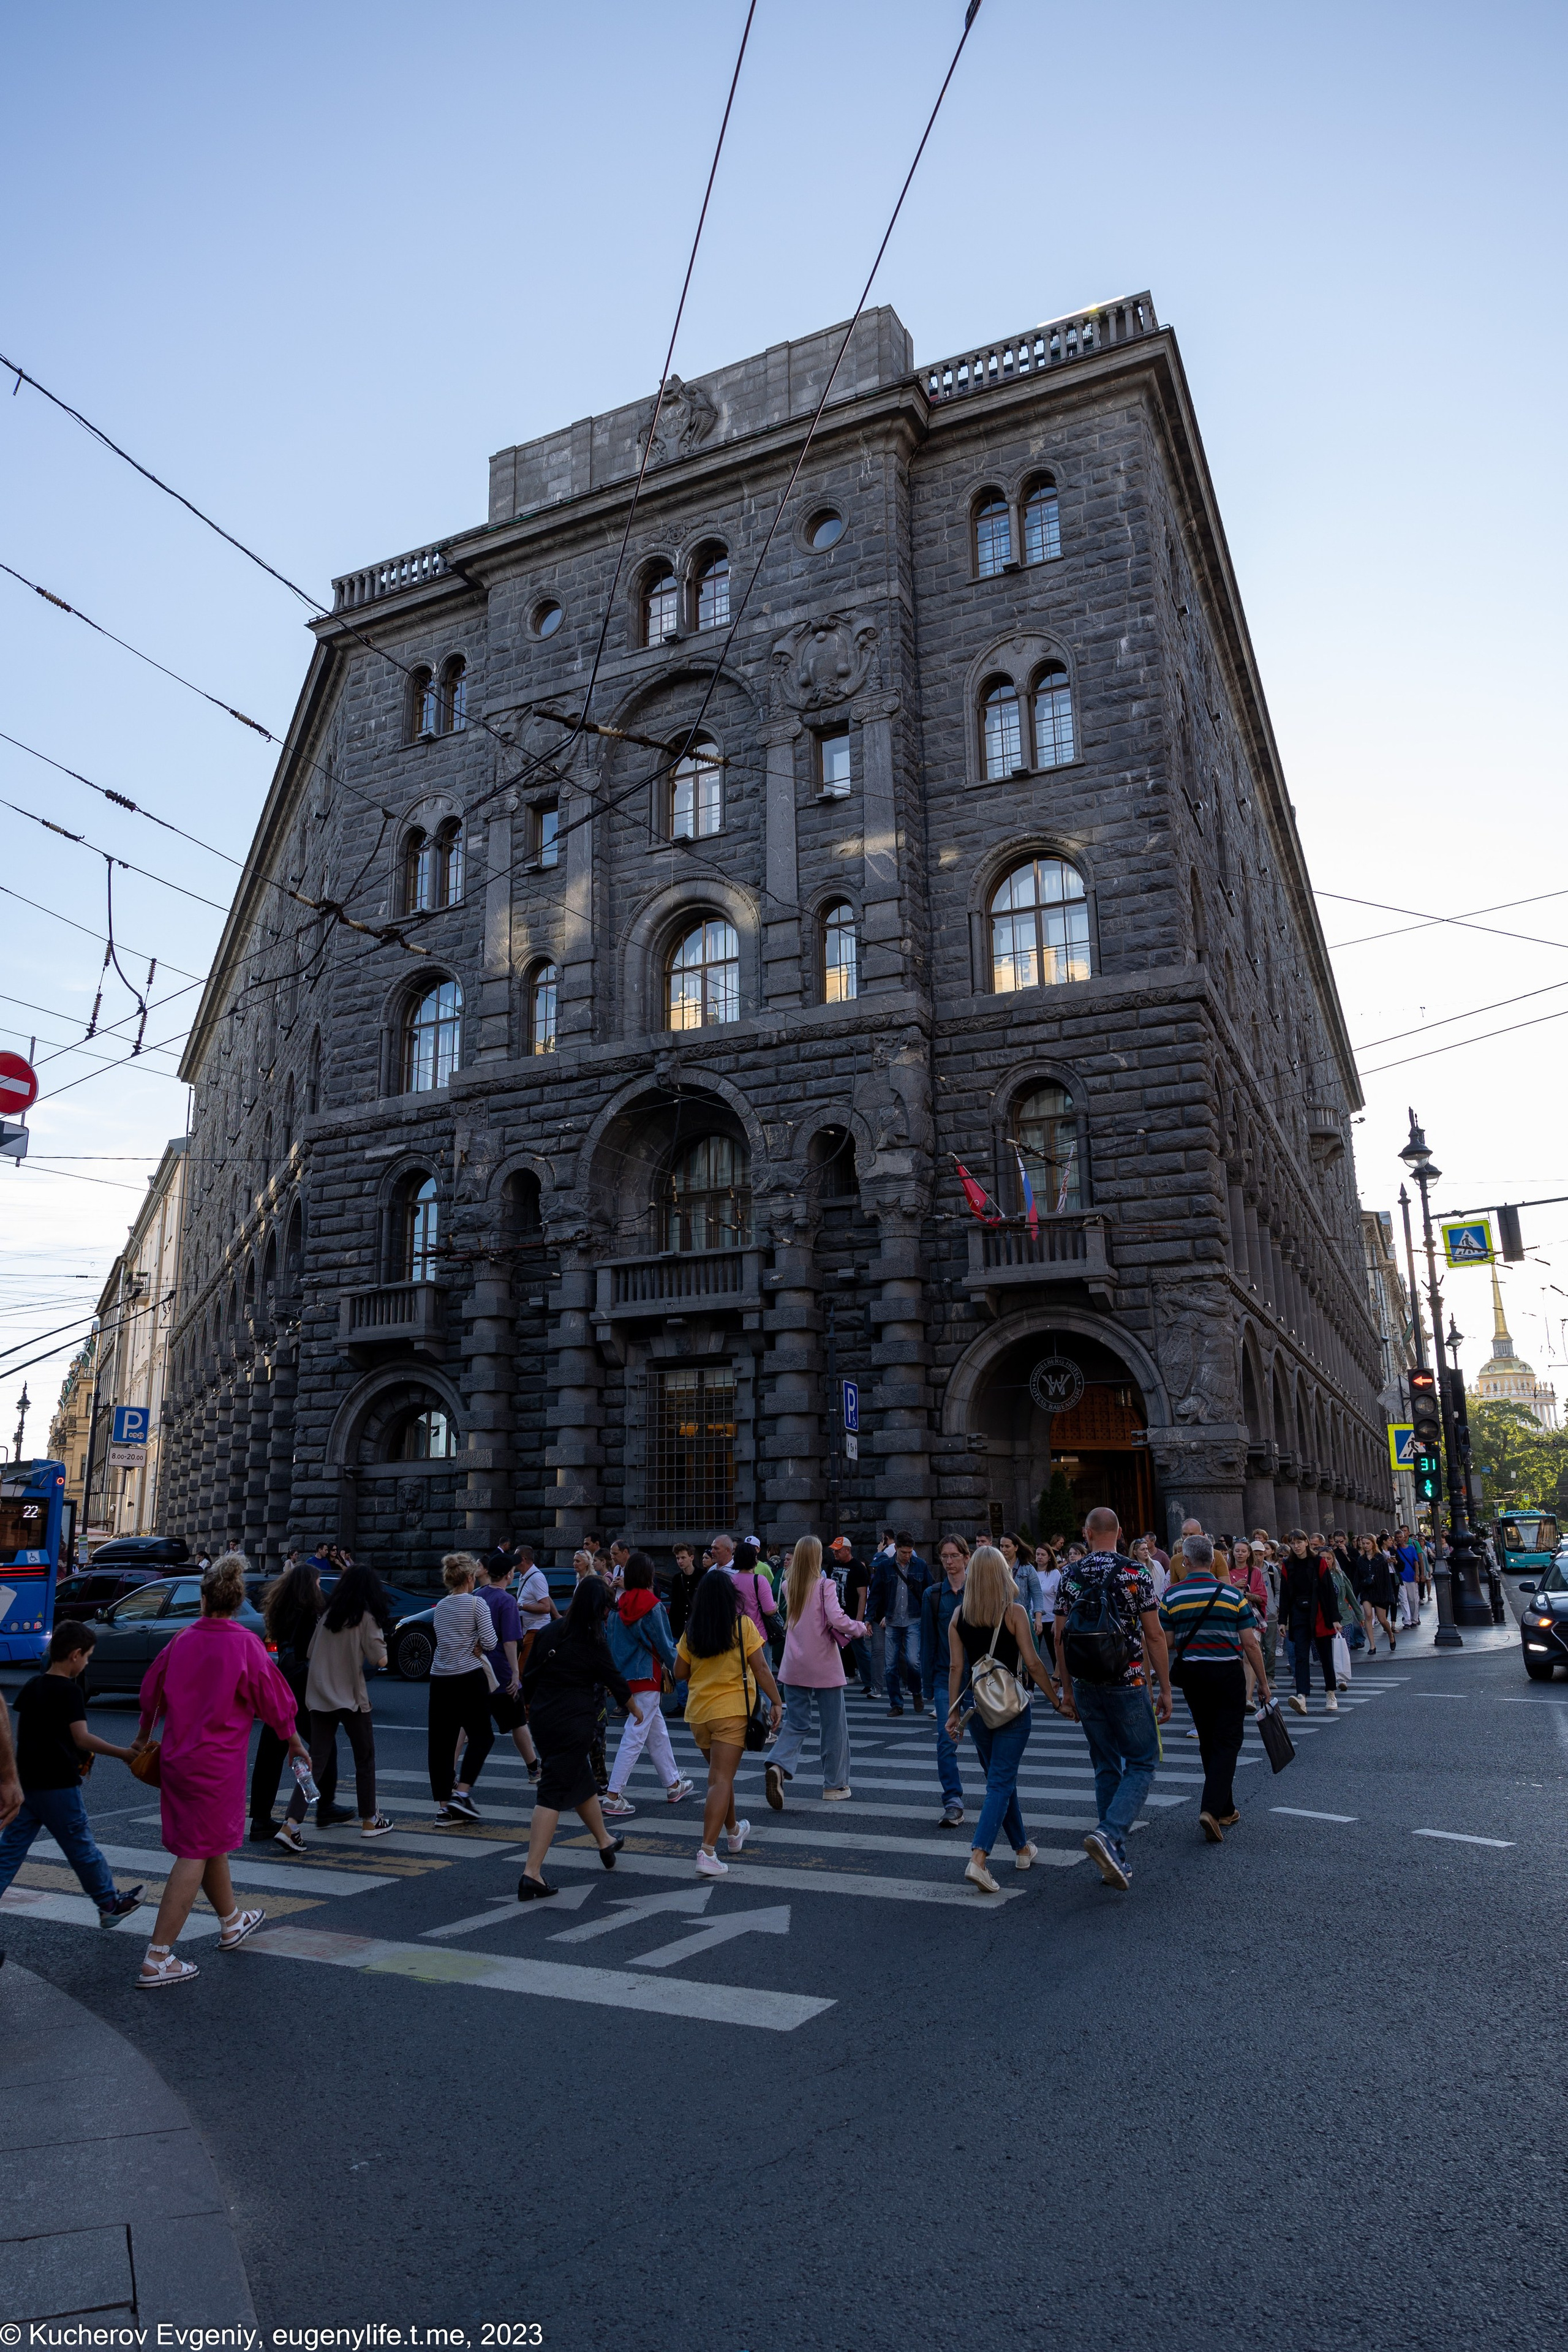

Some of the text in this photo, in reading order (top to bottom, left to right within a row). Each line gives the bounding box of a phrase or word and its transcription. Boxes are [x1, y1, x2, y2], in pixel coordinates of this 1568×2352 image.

[1031, 1357, 1081, 1382] WAWELBERG HOTEL
[848, 1387, 856, 1423] P
[1031, 1387, 1082, 1411] ОТЕЛЬ ВАВЕЛЬБЕРГ
[123, 1411, 143, 1439] P
[111, 1452, 143, 1461] 8.00-20.00
[1421, 1458, 1436, 1471] 31
[23, 1506, 39, 1518] 22
